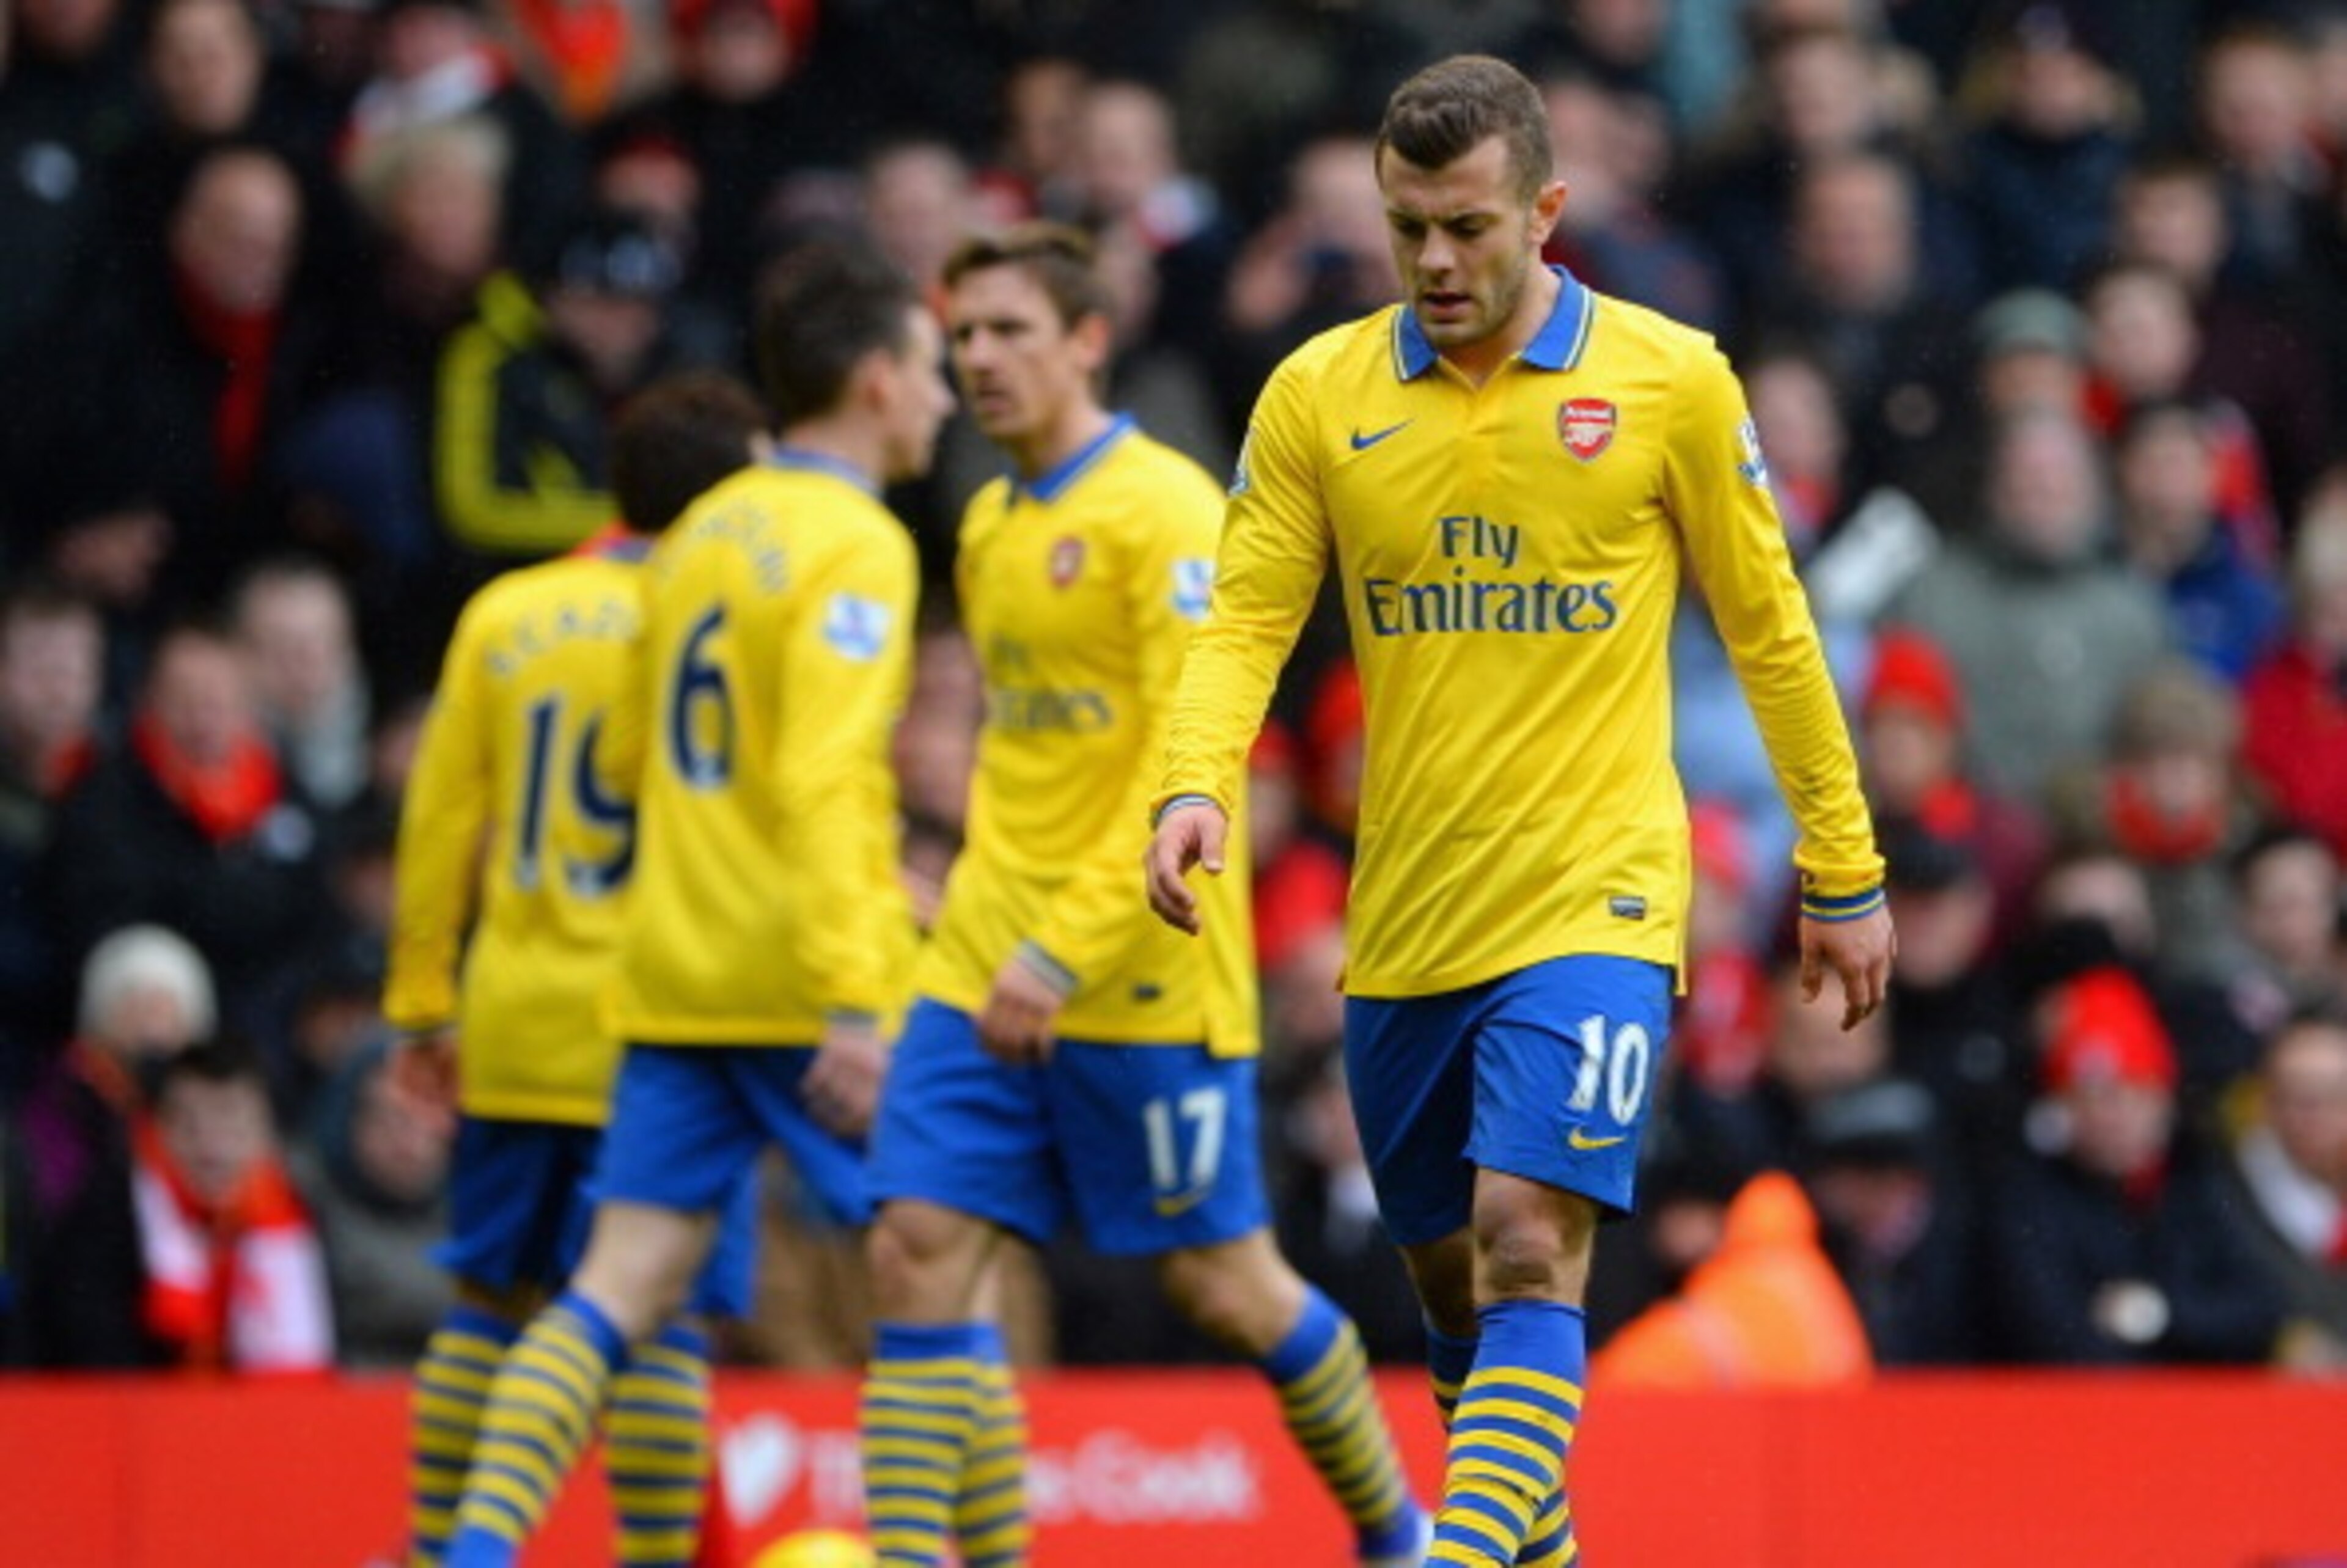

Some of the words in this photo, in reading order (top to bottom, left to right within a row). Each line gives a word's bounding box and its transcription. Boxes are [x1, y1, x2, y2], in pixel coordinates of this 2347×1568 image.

[1440, 516, 1519, 567] Fly
[1364, 566, 1618, 636] Emirates
[667, 601, 736, 789] 6
[1567, 1014, 1650, 1126] 10
[1143, 1085, 1226, 1189] 17
